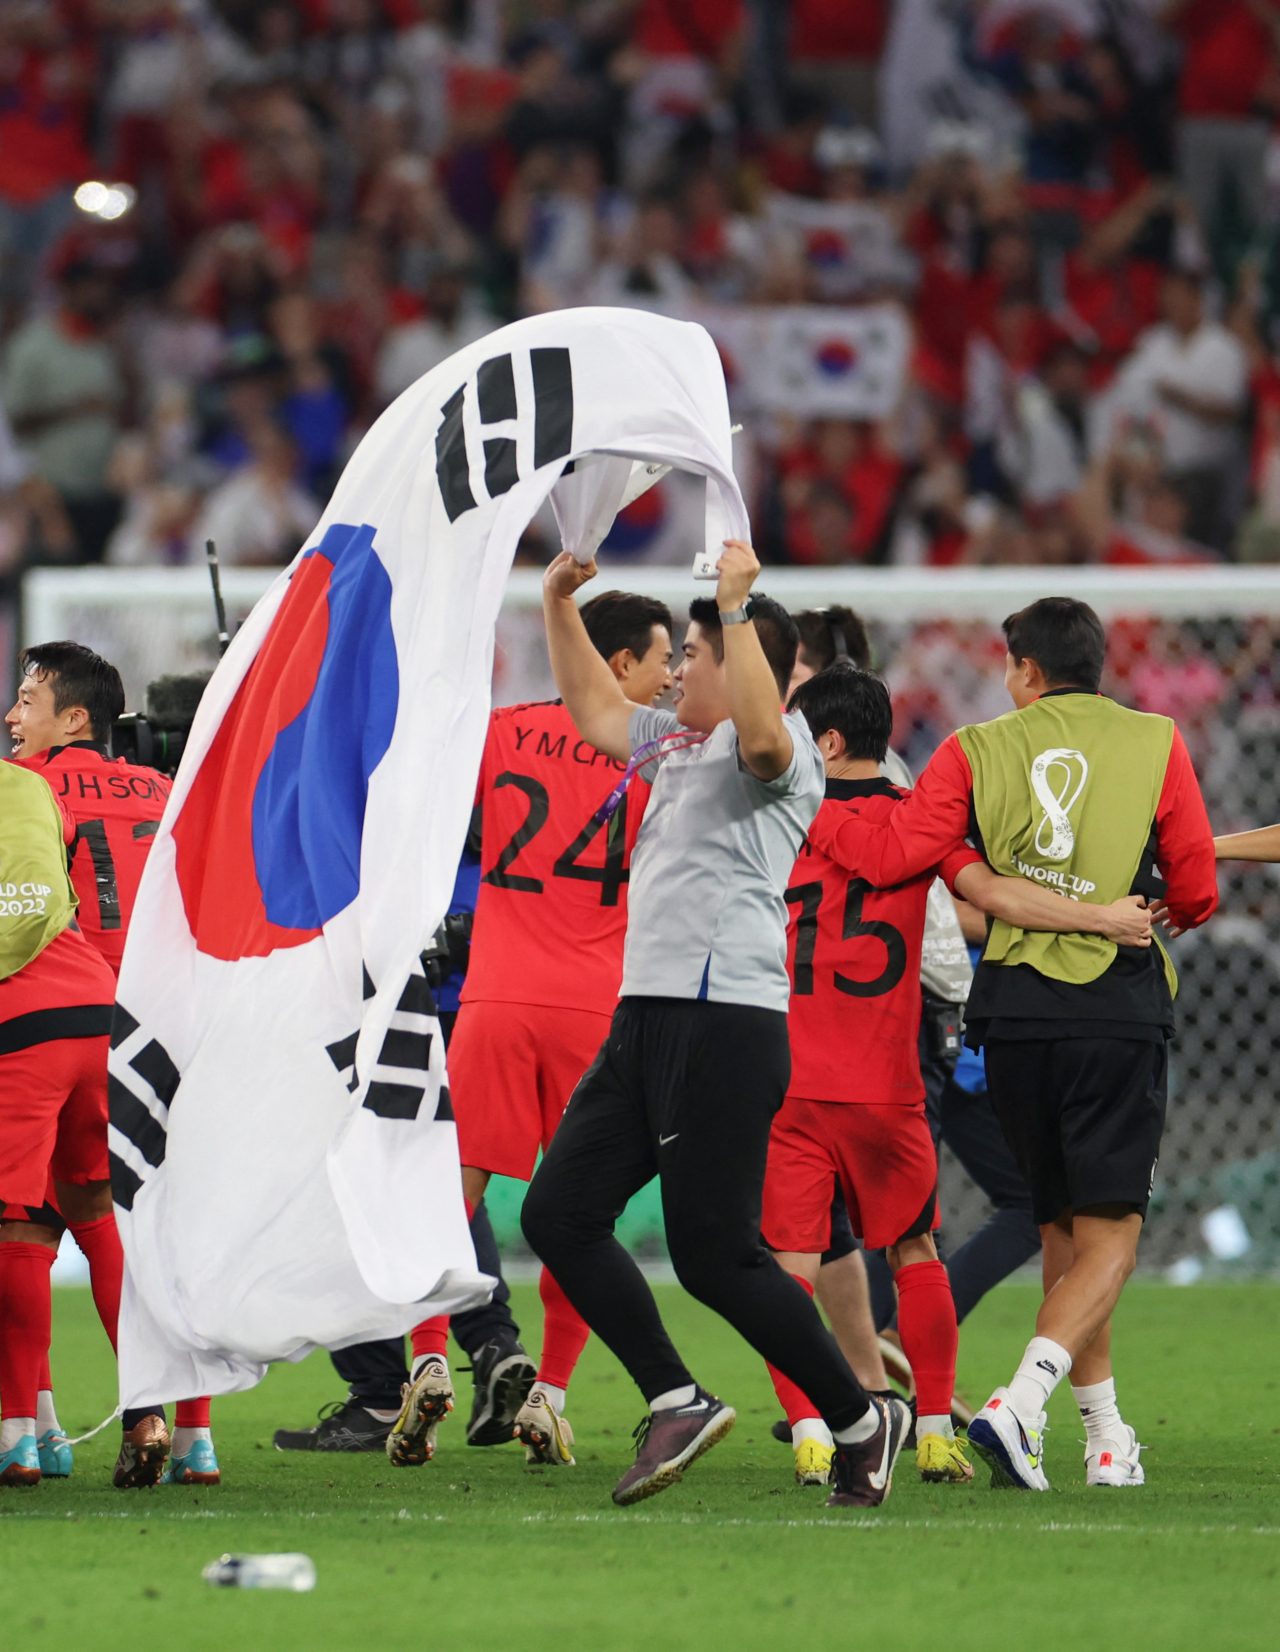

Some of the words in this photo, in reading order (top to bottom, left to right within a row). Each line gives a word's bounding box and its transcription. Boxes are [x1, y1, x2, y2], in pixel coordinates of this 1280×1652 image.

[515, 727, 533, 750] Y
[536, 732, 567, 758] M
[58, 773, 70, 796] J
[77, 774, 102, 799] H
[108, 777, 169, 801] SON
[481, 770, 631, 906] 24
[20, 882, 52, 897] CUP
[77, 819, 162, 930] 1
[783, 876, 907, 998] 15
